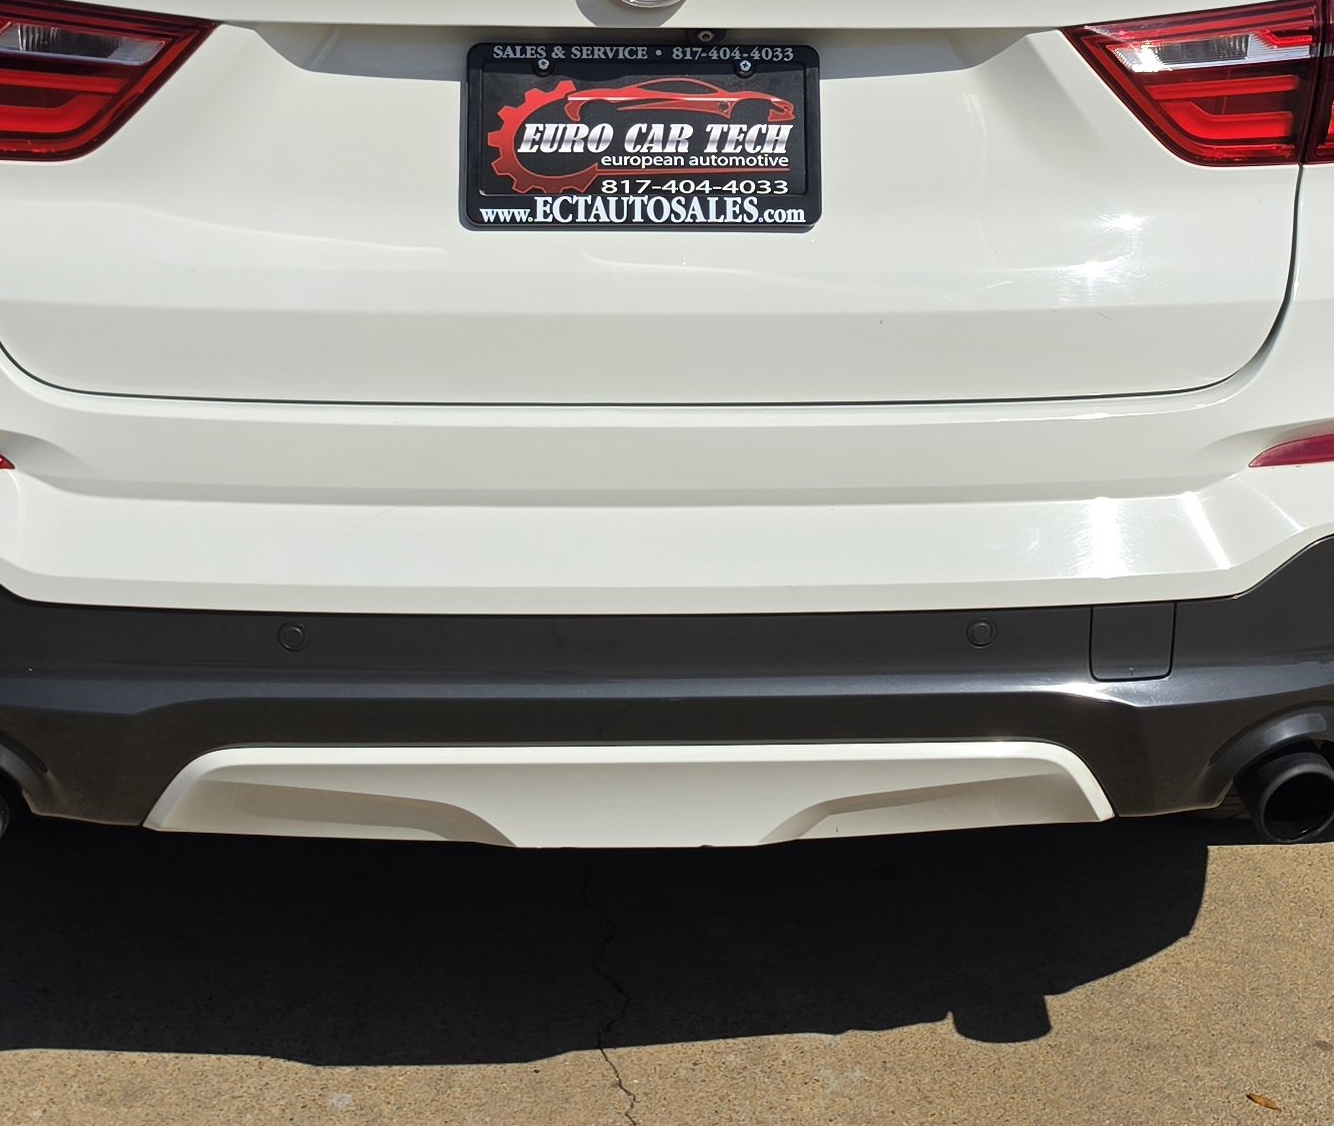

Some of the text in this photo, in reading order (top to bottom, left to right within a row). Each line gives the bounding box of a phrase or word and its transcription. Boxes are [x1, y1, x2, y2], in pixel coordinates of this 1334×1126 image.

[493, 46, 794, 61] SALES & SERVICE 817-404-4033
[517, 123, 794, 154] EURO CAR TECH
[601, 154, 789, 168] european automotive
[601, 179, 789, 194] 817-404-4033
[479, 196, 806, 223] www.ECTAUTOSALES.com
